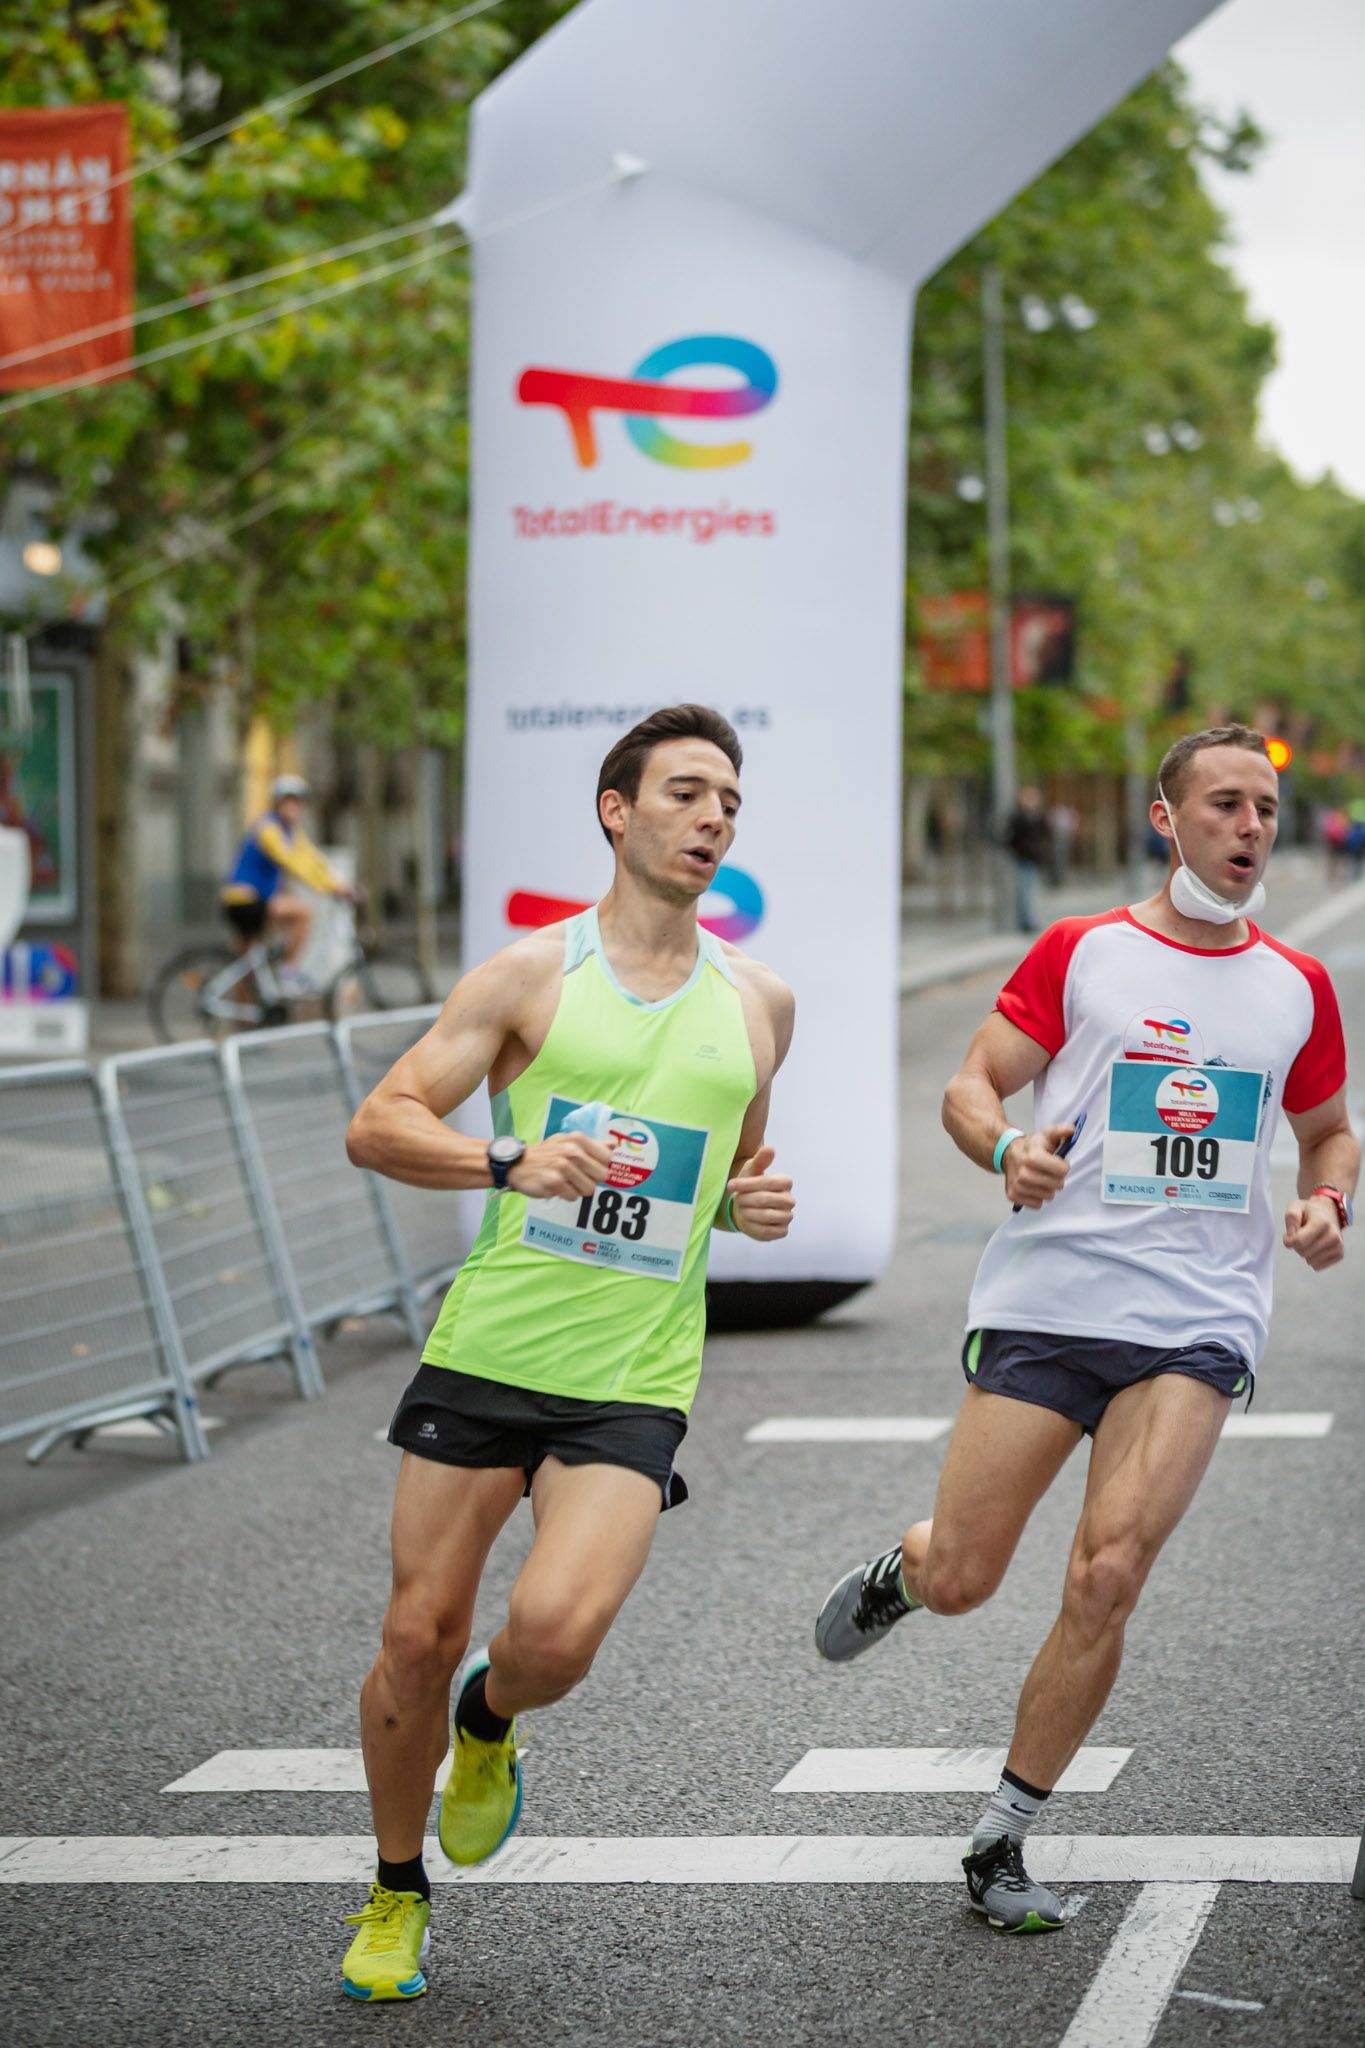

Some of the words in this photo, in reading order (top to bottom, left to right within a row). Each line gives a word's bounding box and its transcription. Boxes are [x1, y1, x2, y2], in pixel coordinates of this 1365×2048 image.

[513, 501, 775, 543] TotalEnergies
[1143, 1040, 1190, 1056] TotalEnergies
[1151, 1135, 1220, 1180] 109
[1120, 1185, 1155, 1195] MADRID
[576, 1189, 650, 1241] 183
[538, 1229, 573, 1247] MADRID
